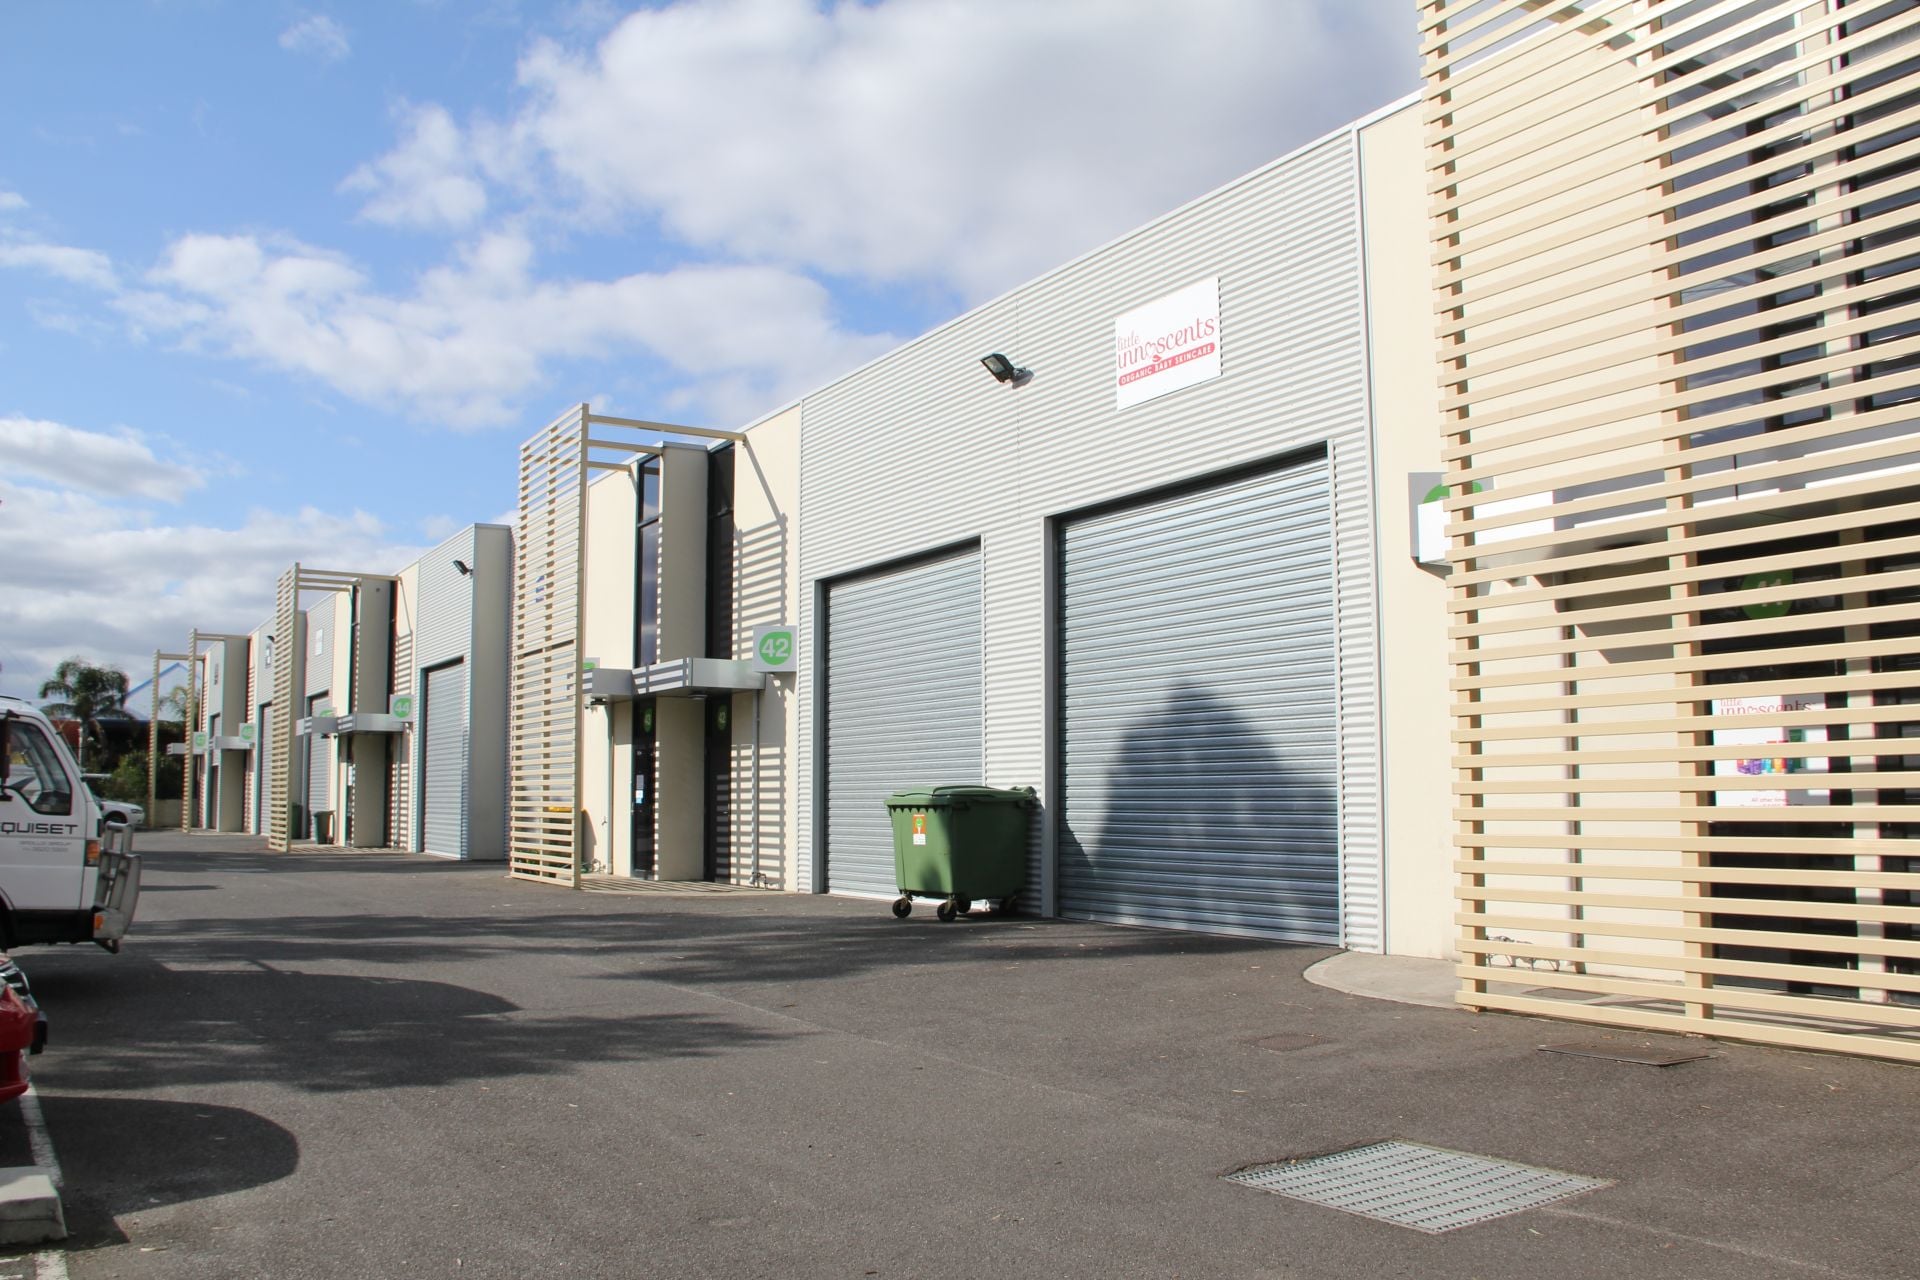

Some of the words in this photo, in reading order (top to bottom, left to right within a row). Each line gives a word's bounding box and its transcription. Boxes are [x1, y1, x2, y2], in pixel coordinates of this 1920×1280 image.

[1117, 330, 1139, 351] little
[1118, 317, 1215, 369] innoscents
[1121, 366, 1153, 385] ORGANIC
[1154, 358, 1173, 372] BABY
[1174, 344, 1212, 365] SKINCARE
[761, 638, 789, 658] 42
[394, 701, 411, 714] 44
